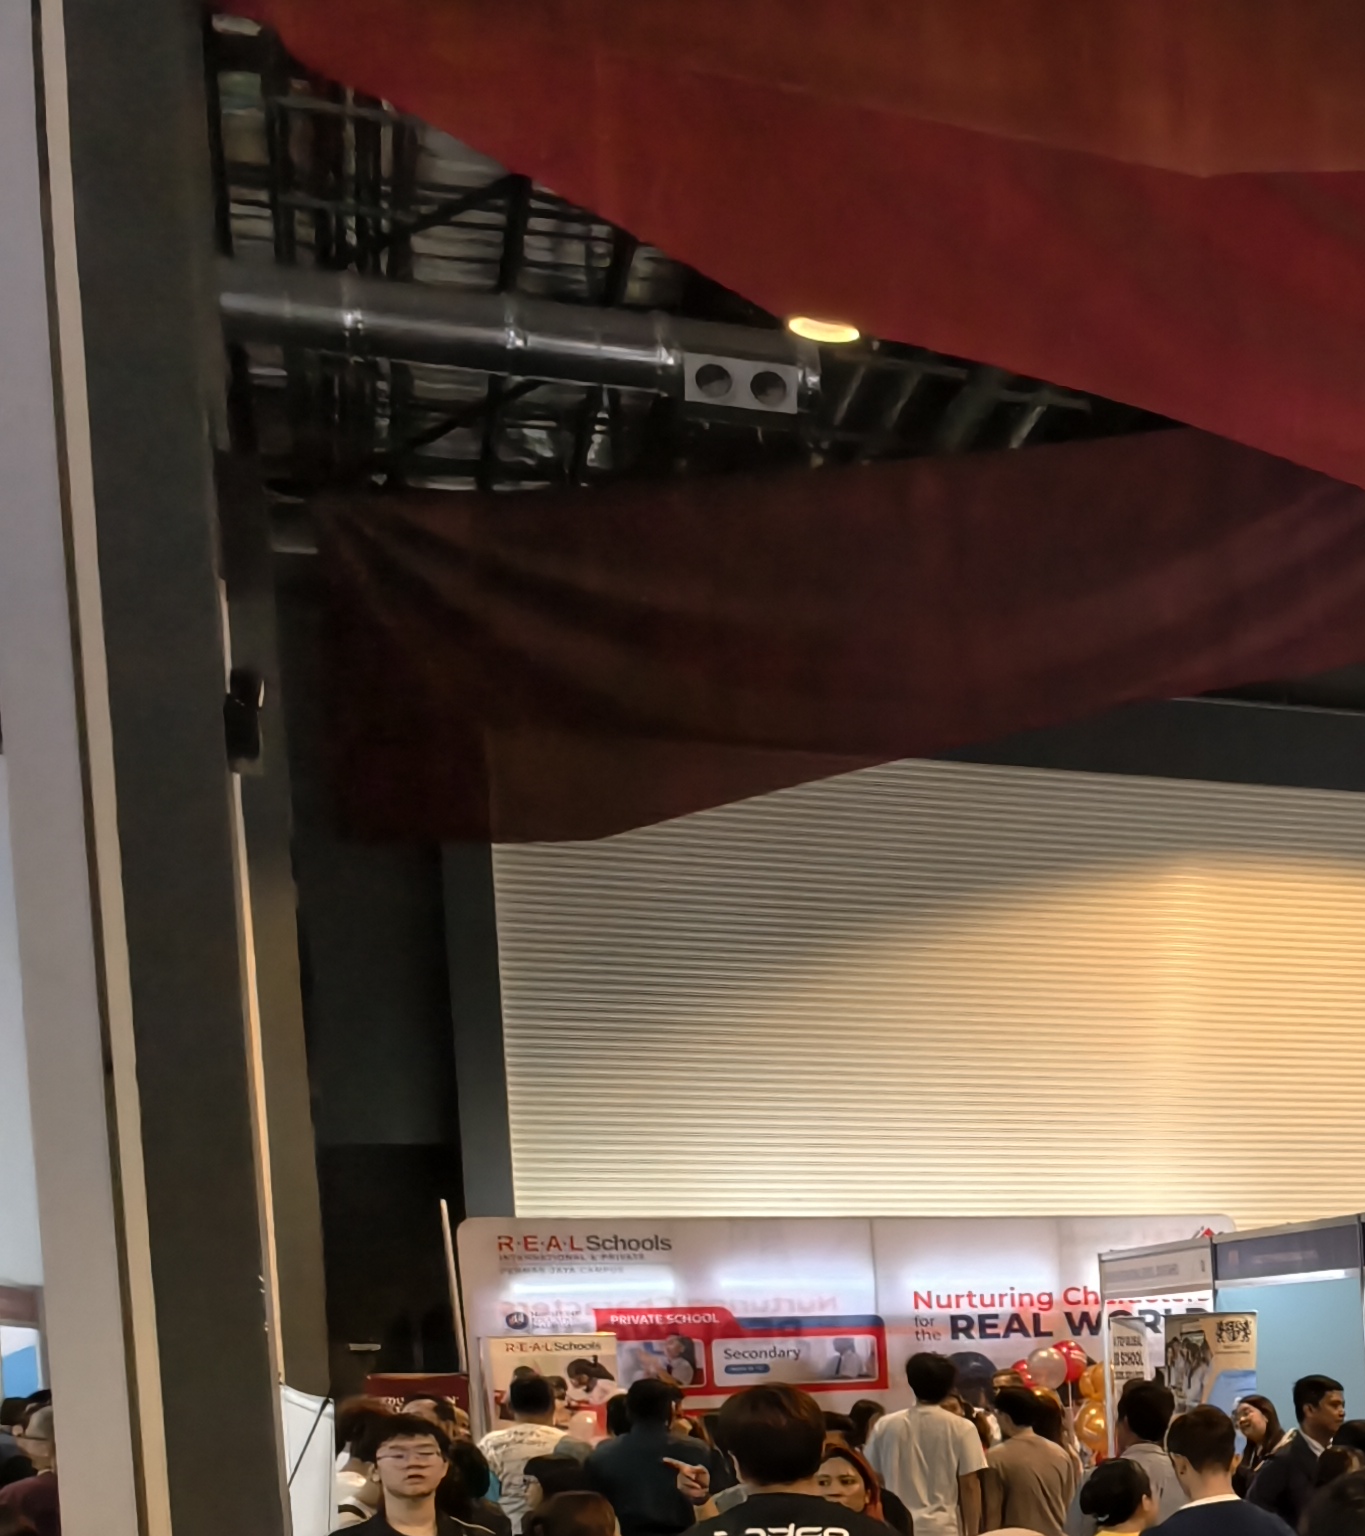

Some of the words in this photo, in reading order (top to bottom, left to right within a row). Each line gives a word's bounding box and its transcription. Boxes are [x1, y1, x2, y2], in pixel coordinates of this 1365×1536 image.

[586, 1234, 672, 1251] Schools
[913, 1287, 1054, 1311] Nurturing
[610, 1314, 664, 1326] PRIVATE
[666, 1312, 720, 1324] SCHOOL
[914, 1315, 935, 1329] for
[950, 1313, 1053, 1341] REAL
[914, 1329, 941, 1342] the
[724, 1346, 800, 1362] Secondary
